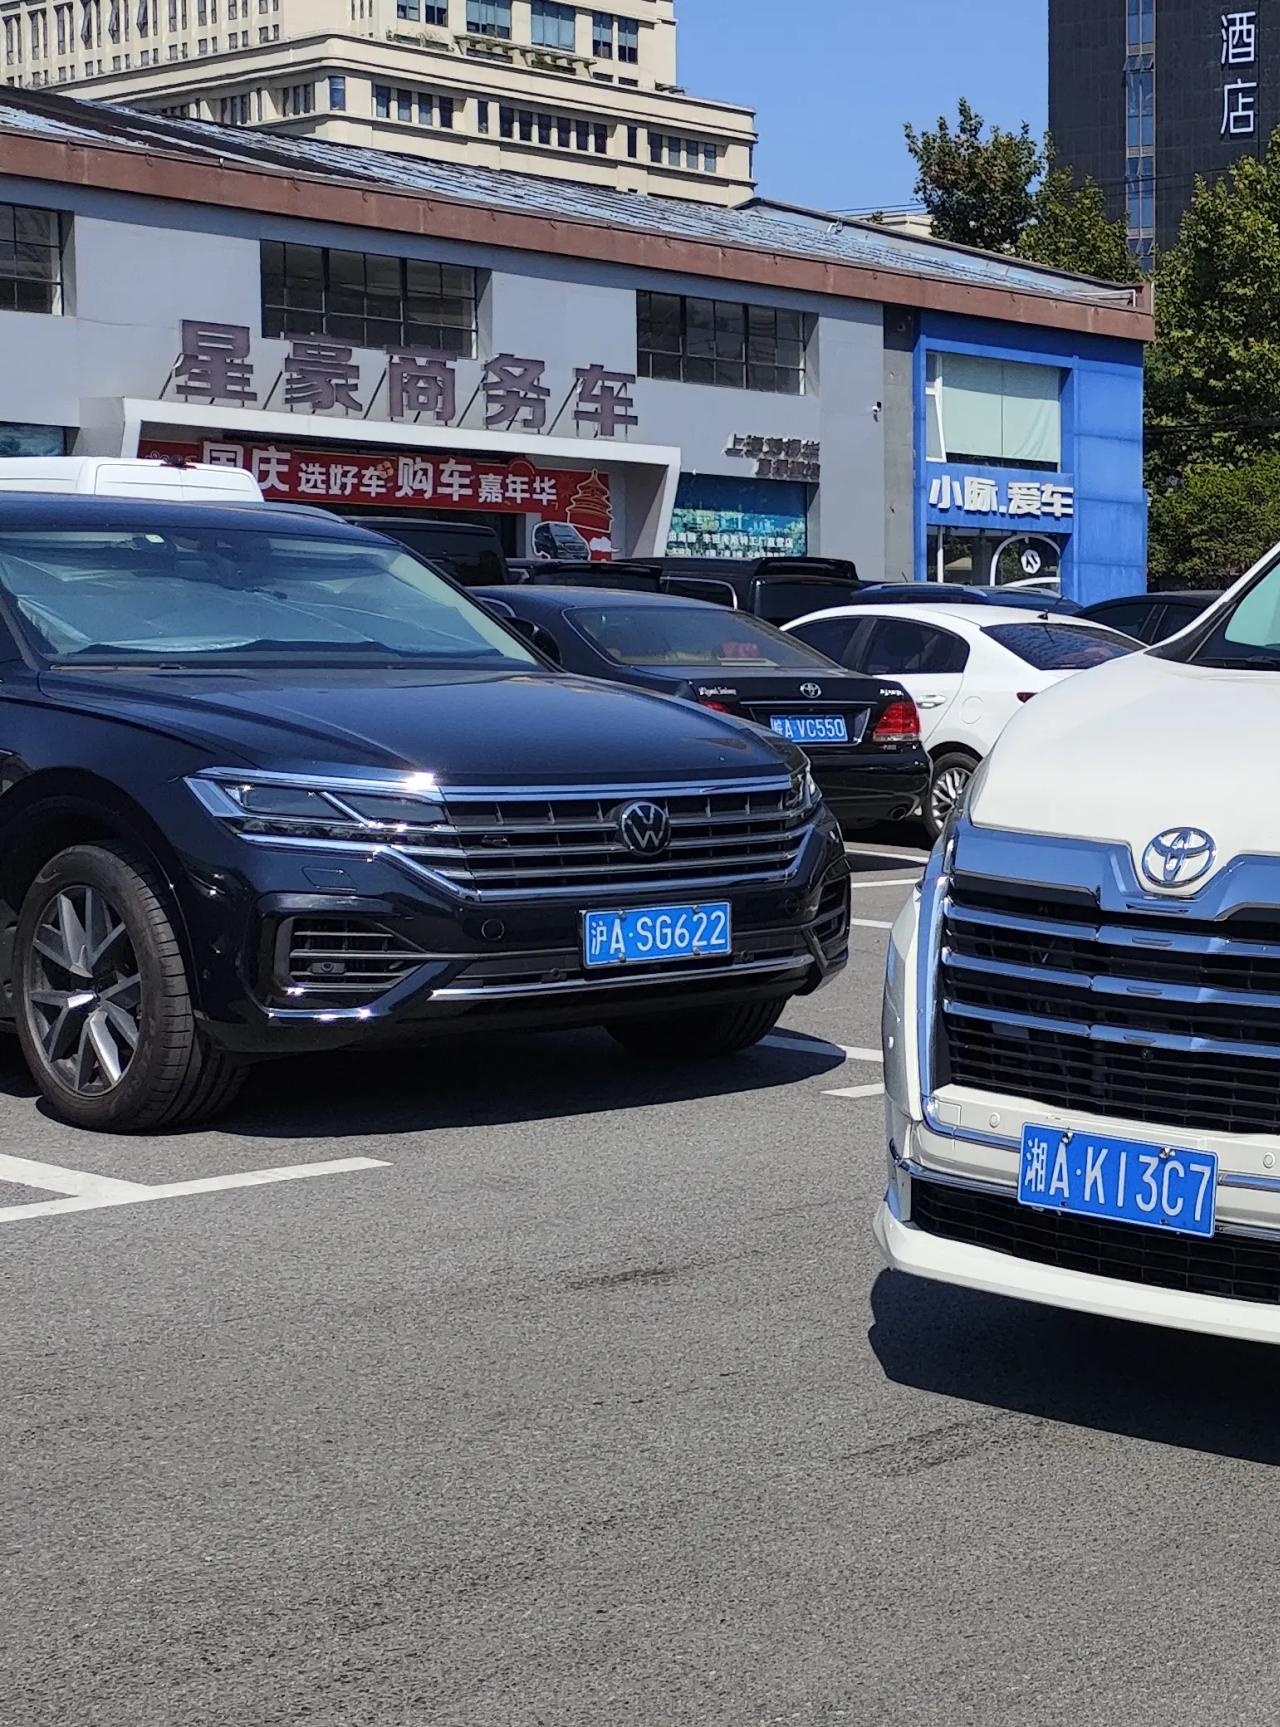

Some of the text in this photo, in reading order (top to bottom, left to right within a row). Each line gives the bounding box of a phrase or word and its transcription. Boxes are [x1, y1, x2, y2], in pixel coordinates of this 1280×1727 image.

[1221, 10, 1257, 135] 酒店
[175, 319, 639, 437] 星豪商务车
